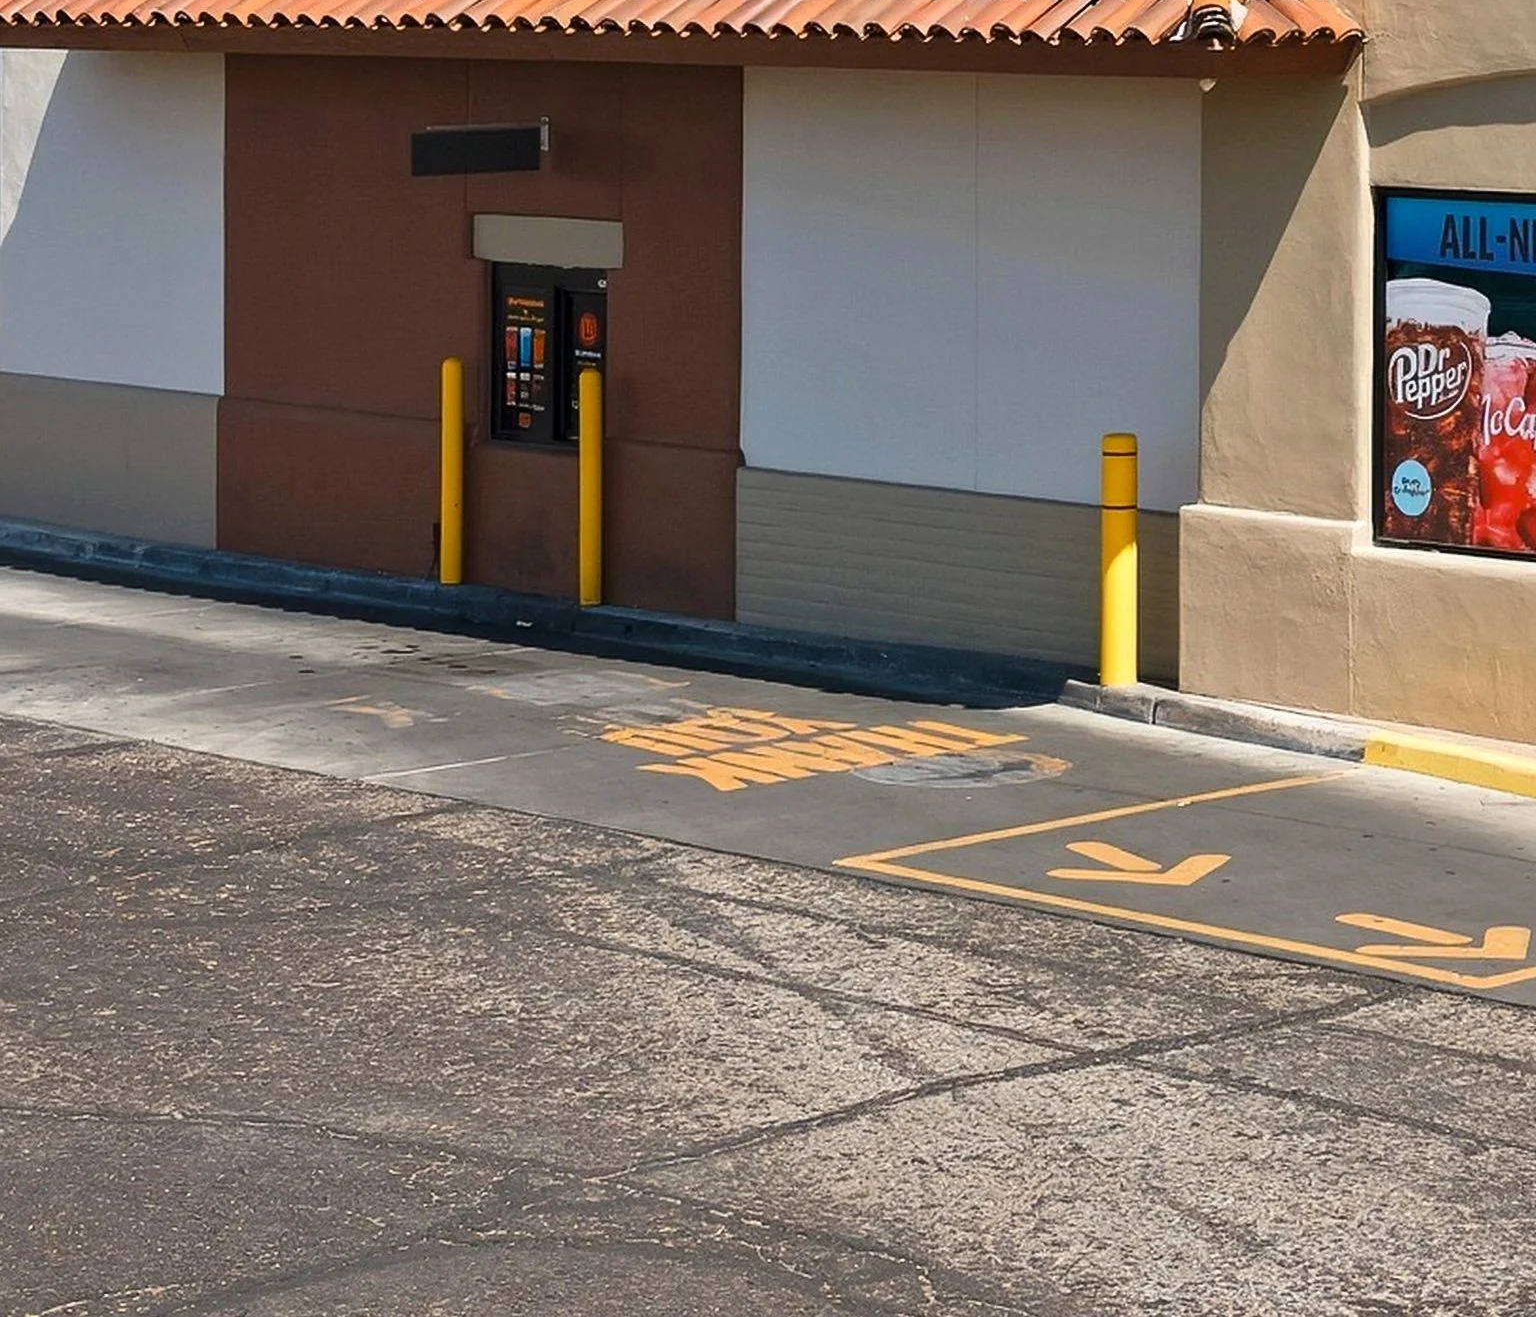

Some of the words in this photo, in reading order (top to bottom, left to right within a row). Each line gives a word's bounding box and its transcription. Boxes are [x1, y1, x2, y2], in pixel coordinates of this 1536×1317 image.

[1389, 346, 1467, 410] Pepper
[1417, 342, 1451, 377] Dr
[634, 720, 1030, 792] THANK
